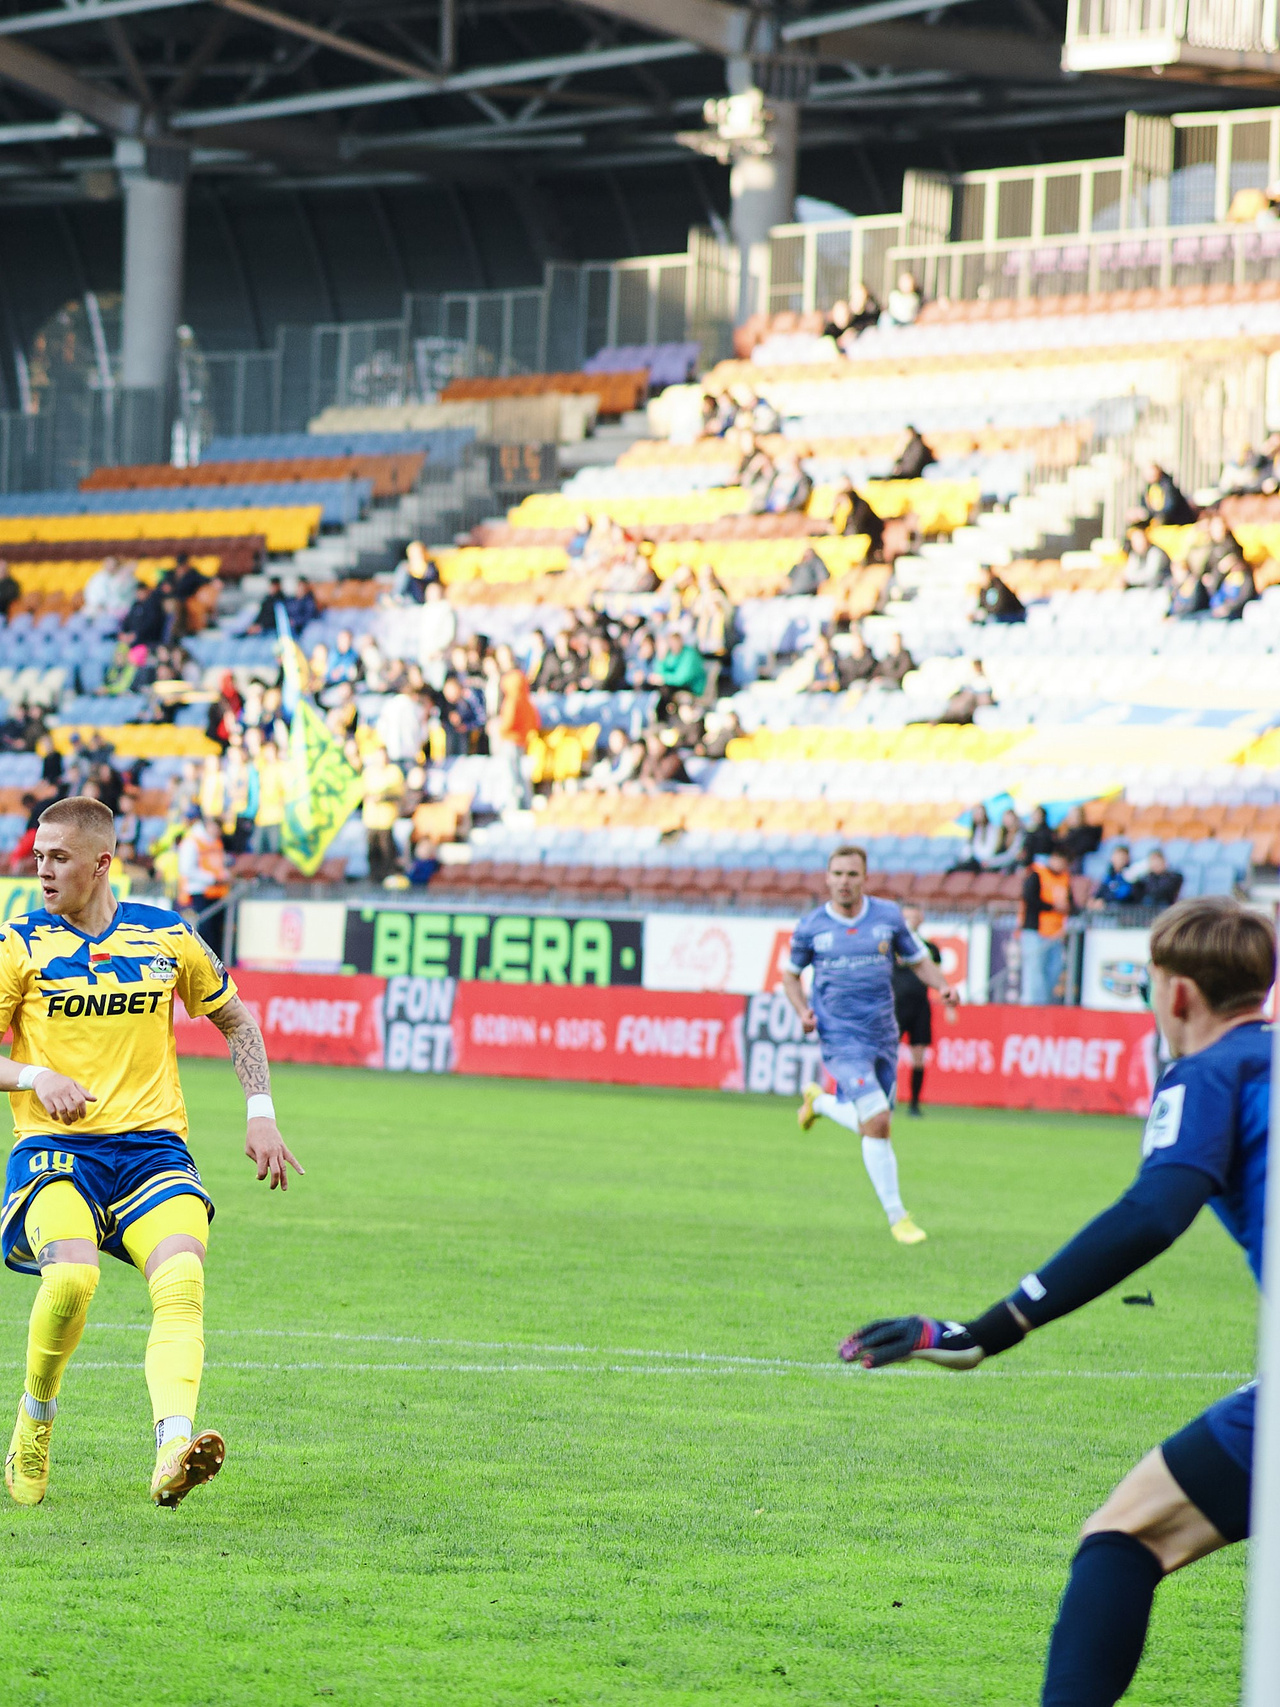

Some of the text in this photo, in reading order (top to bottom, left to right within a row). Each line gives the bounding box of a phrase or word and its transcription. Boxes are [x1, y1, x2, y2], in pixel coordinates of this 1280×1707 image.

[47, 991, 164, 1018] FONBET
[265, 996, 361, 1036] FONBET
[387, 976, 455, 1021] FON
[388, 1021, 454, 1073] BET
[616, 1015, 724, 1059] FONBET
[1001, 1033, 1126, 1081] FONBET
[749, 1040, 822, 1096] BET
